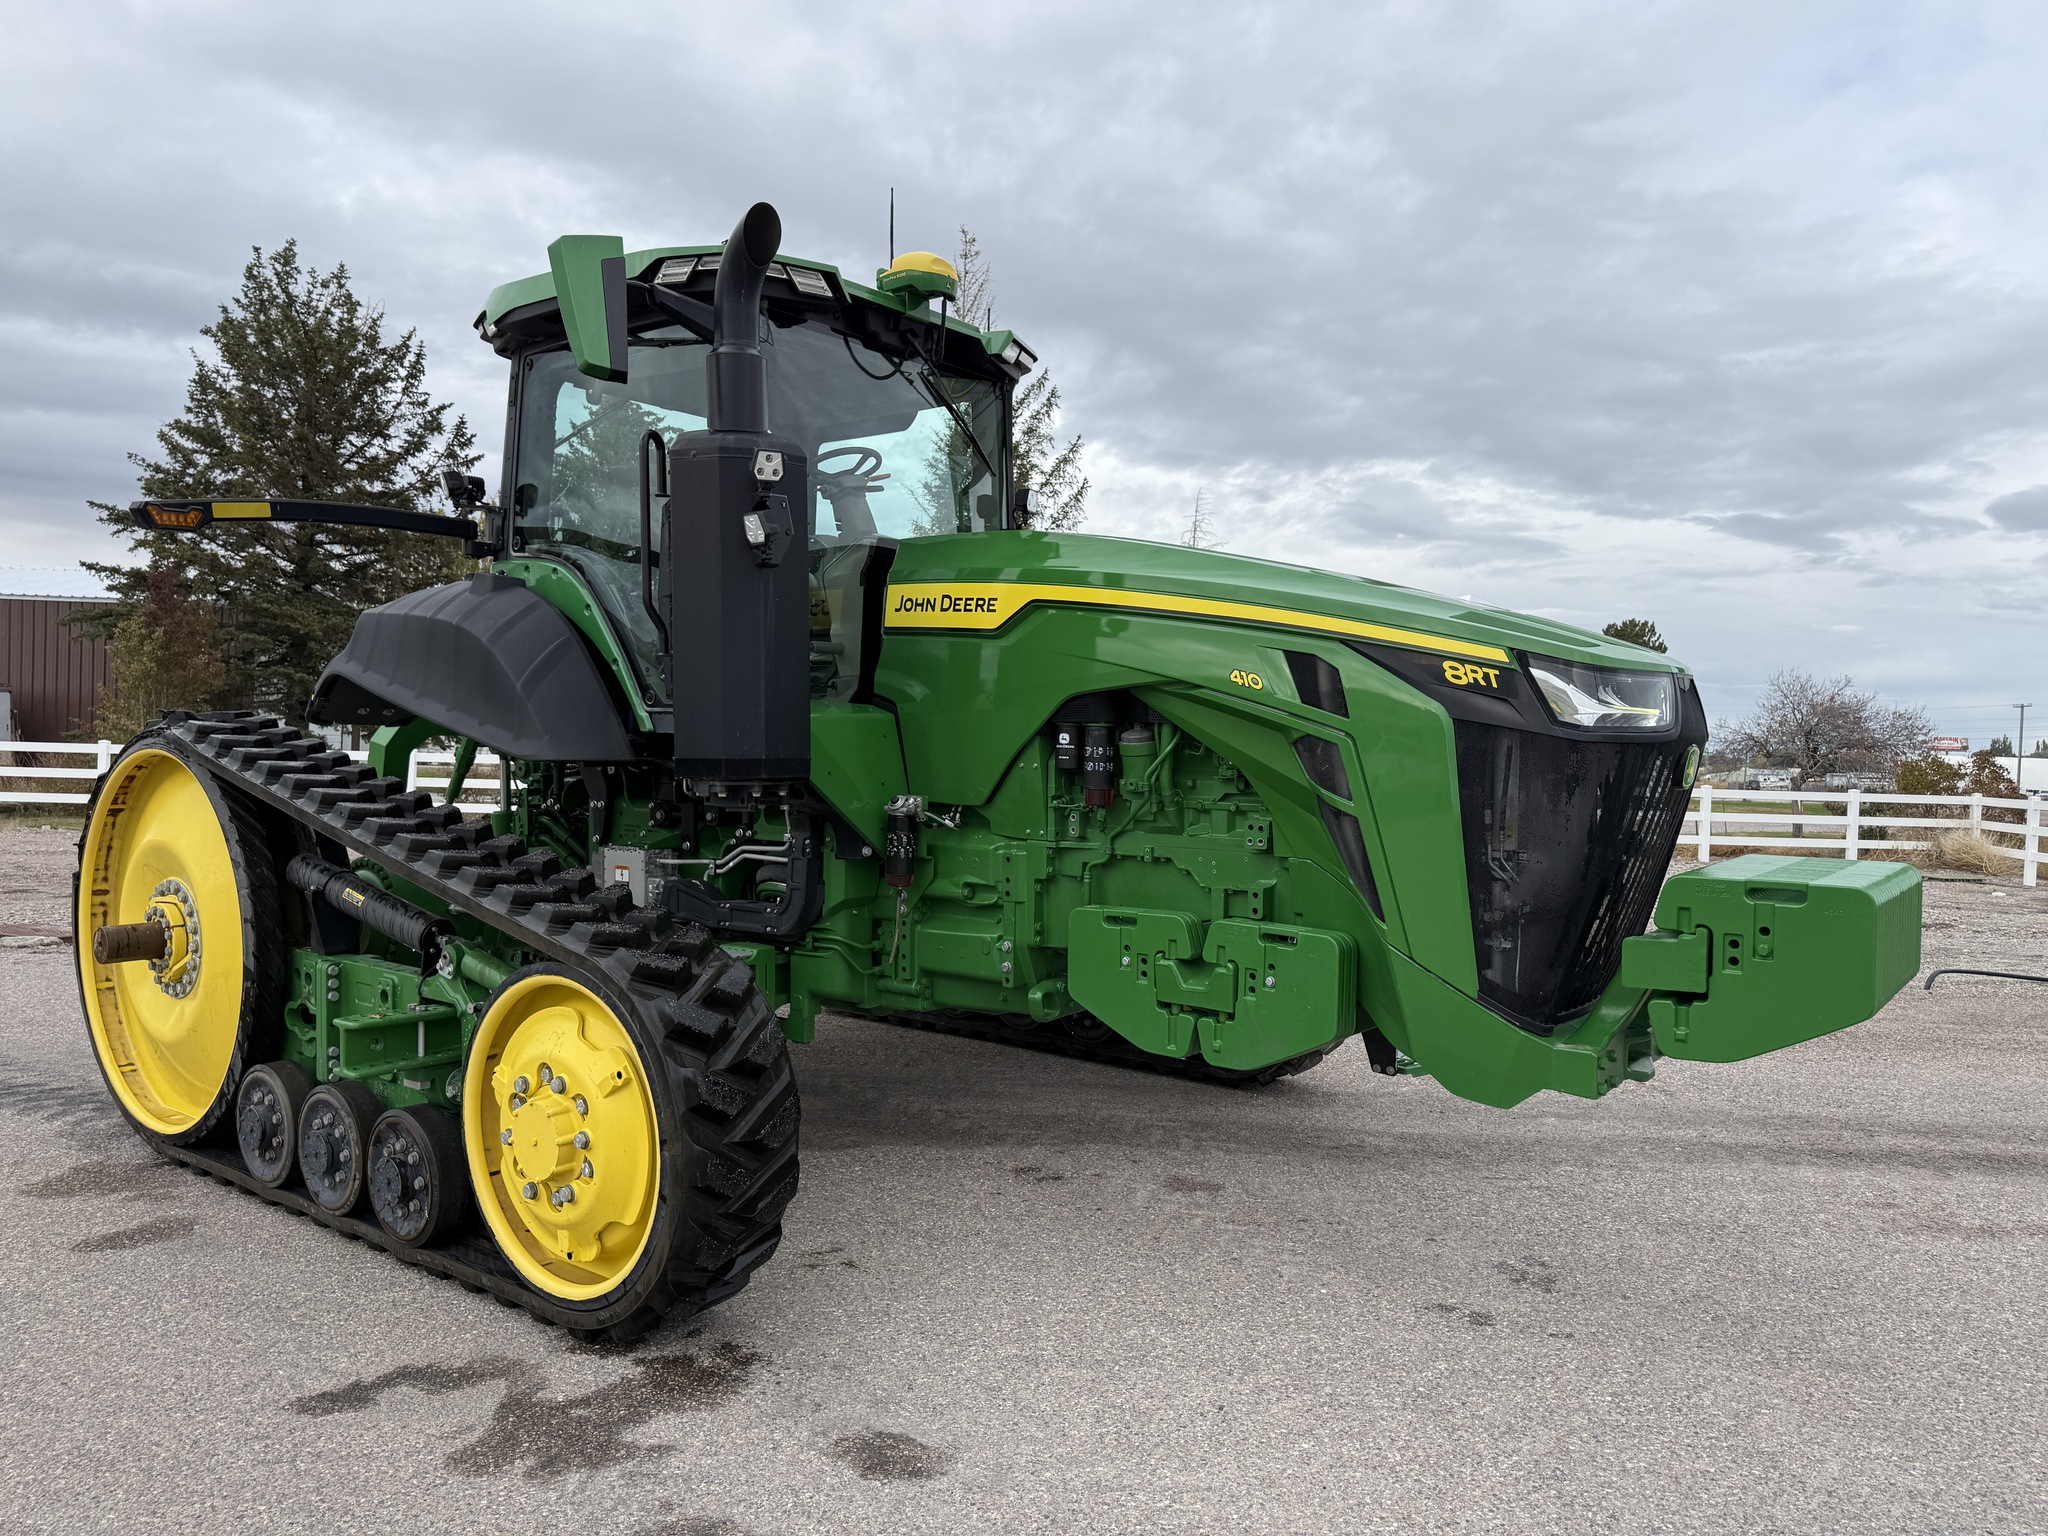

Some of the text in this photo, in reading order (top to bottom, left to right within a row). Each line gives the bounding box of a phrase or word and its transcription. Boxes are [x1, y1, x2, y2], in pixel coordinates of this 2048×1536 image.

[894, 594, 998, 613] JOHN DEERE
[1229, 669, 1263, 690] 410
[1441, 660, 1500, 689] 8RT
